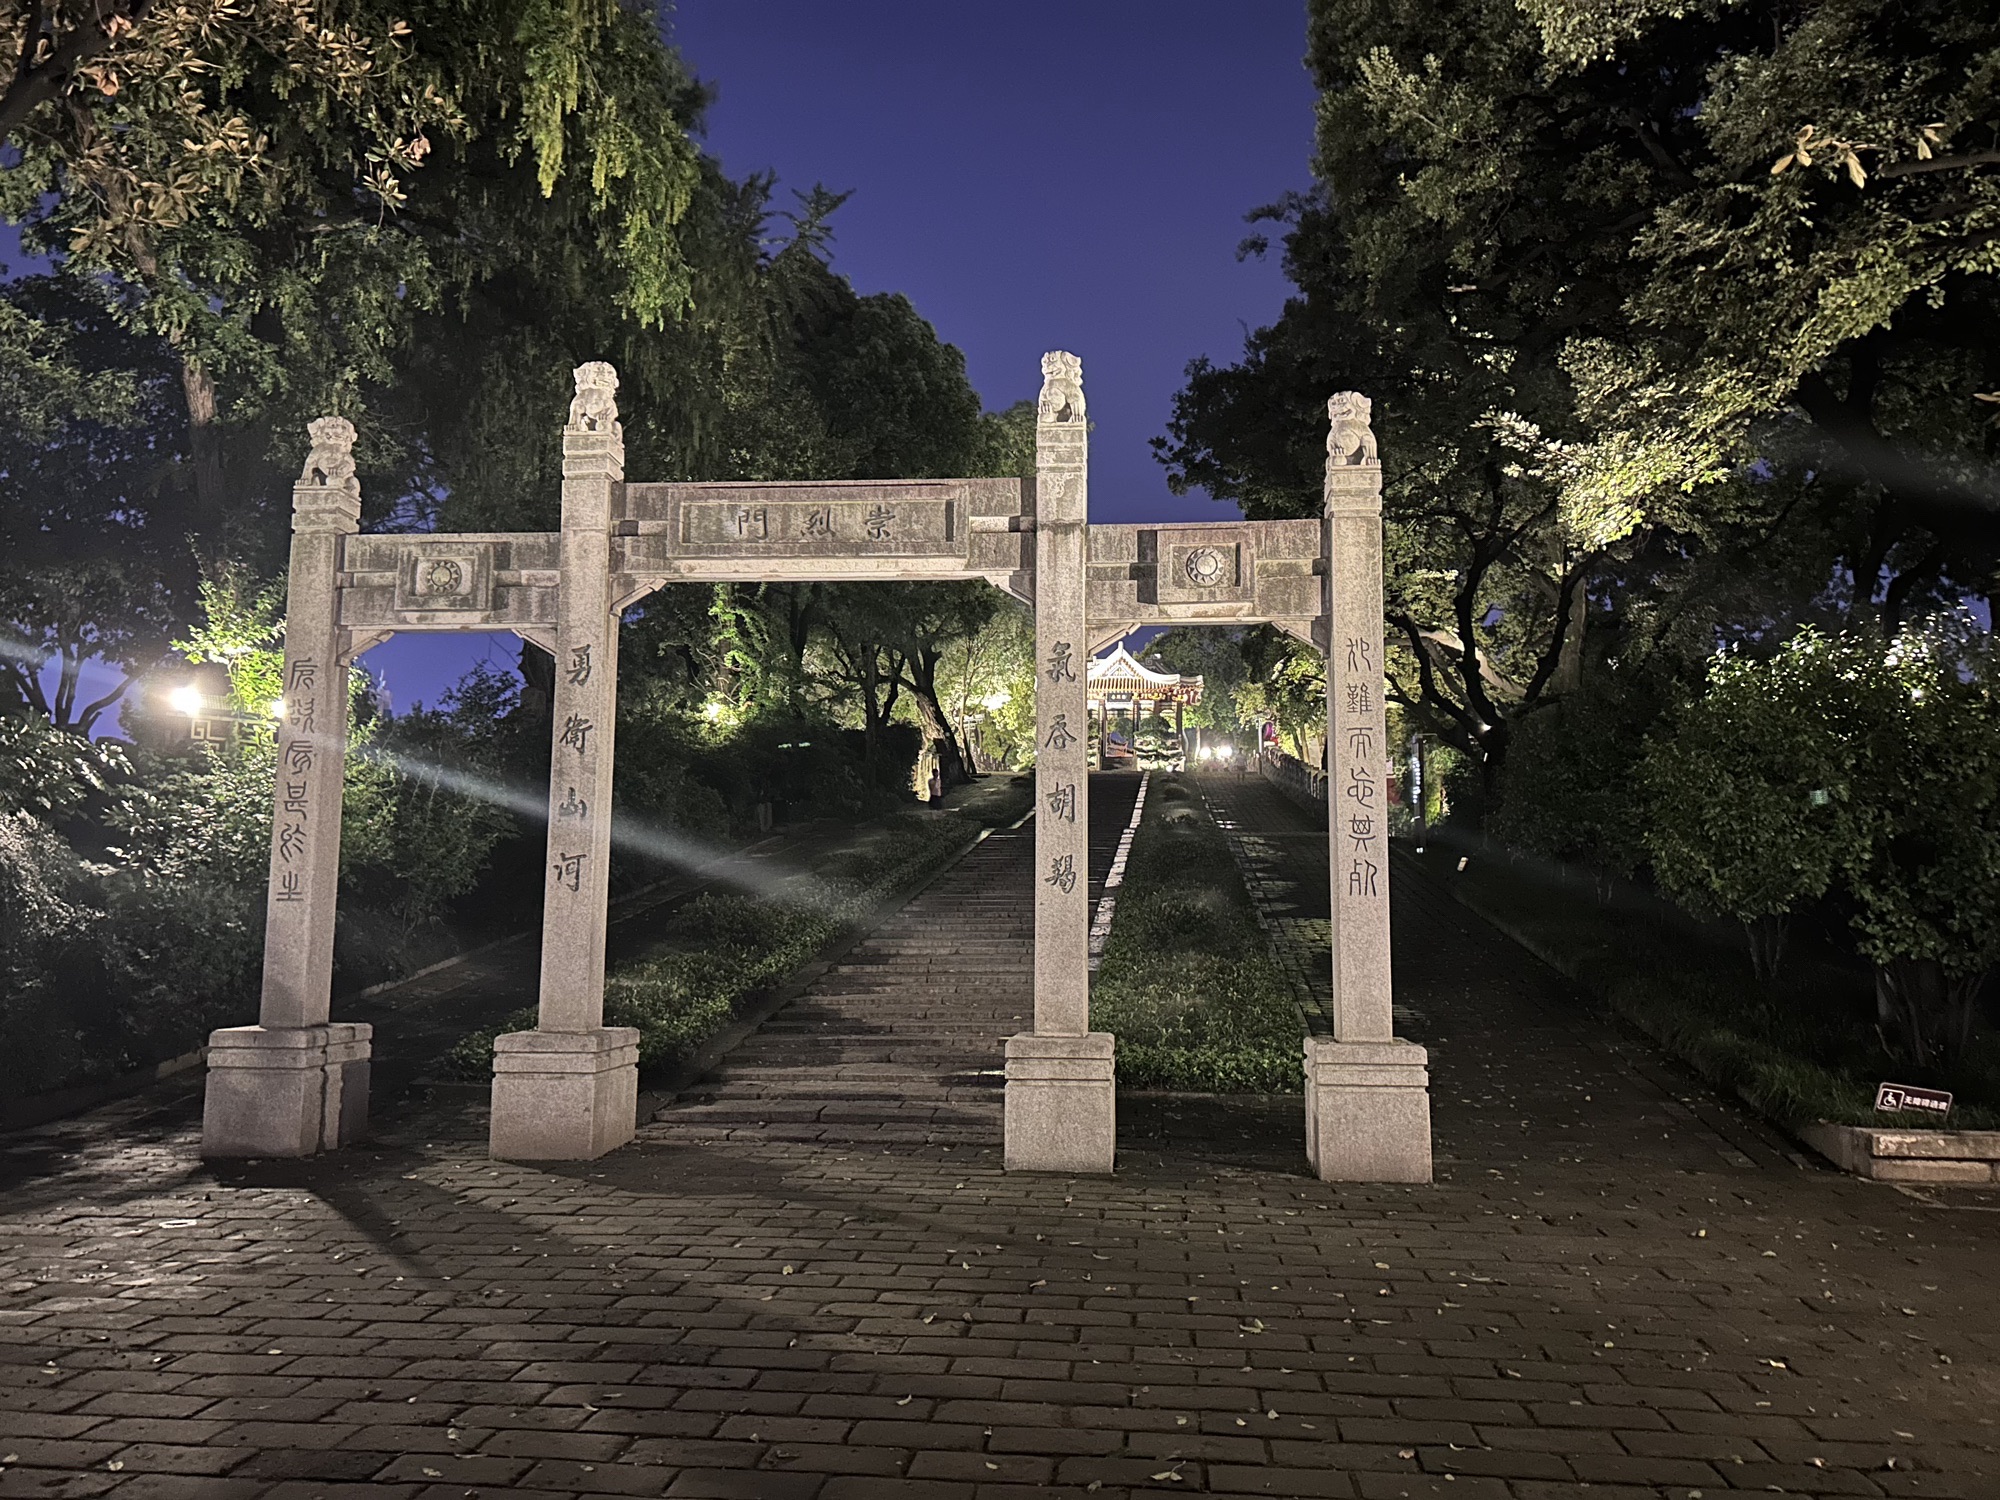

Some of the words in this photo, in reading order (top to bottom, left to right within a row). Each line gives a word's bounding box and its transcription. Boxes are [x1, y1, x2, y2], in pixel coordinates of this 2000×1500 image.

[553, 643, 593, 893] 勇衛山河
[1044, 641, 1078, 895] 氣吞胡羯
